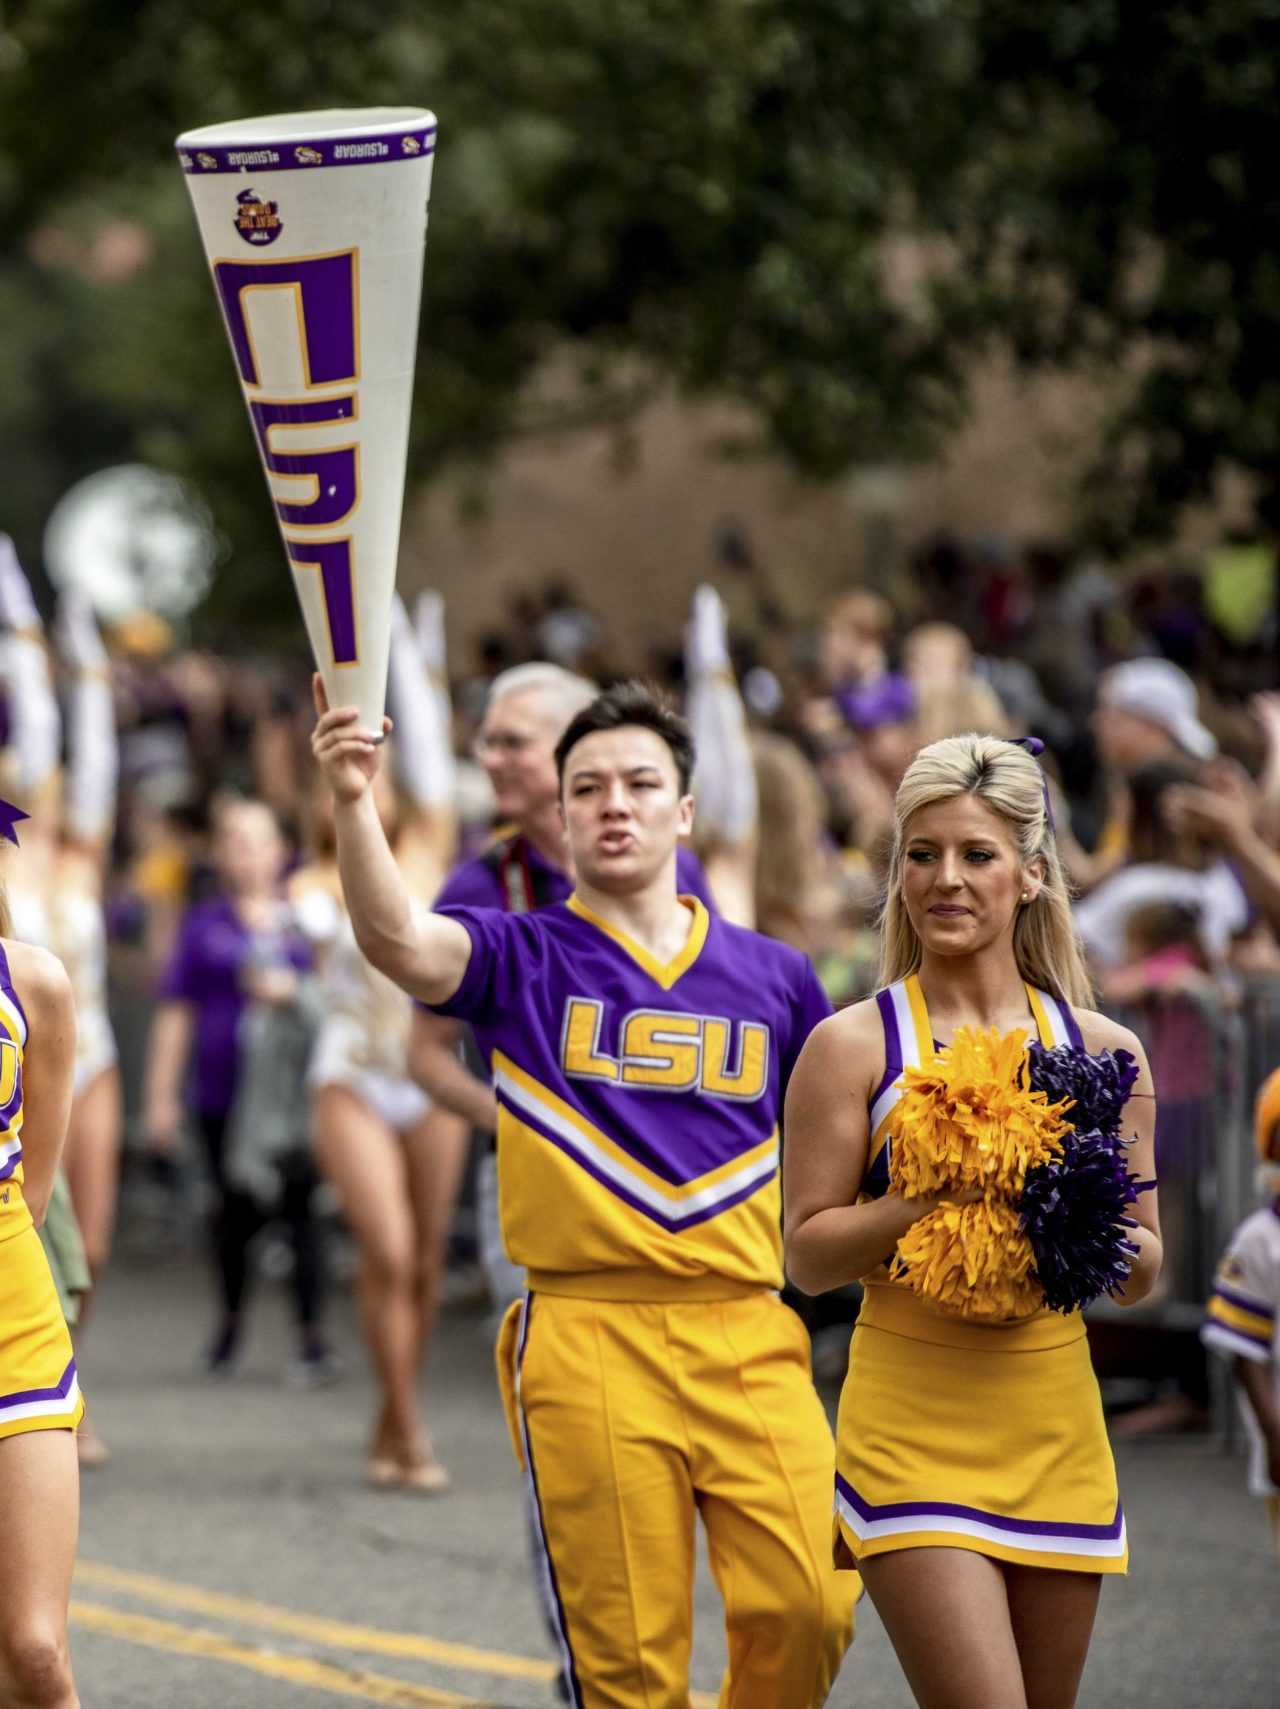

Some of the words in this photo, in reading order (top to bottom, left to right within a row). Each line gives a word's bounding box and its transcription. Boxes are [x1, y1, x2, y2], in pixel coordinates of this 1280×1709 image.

[228, 150, 280, 166] #LSUROAR
[334, 142, 388, 159] #LSUROAR
[560, 995, 769, 1103] LSU
